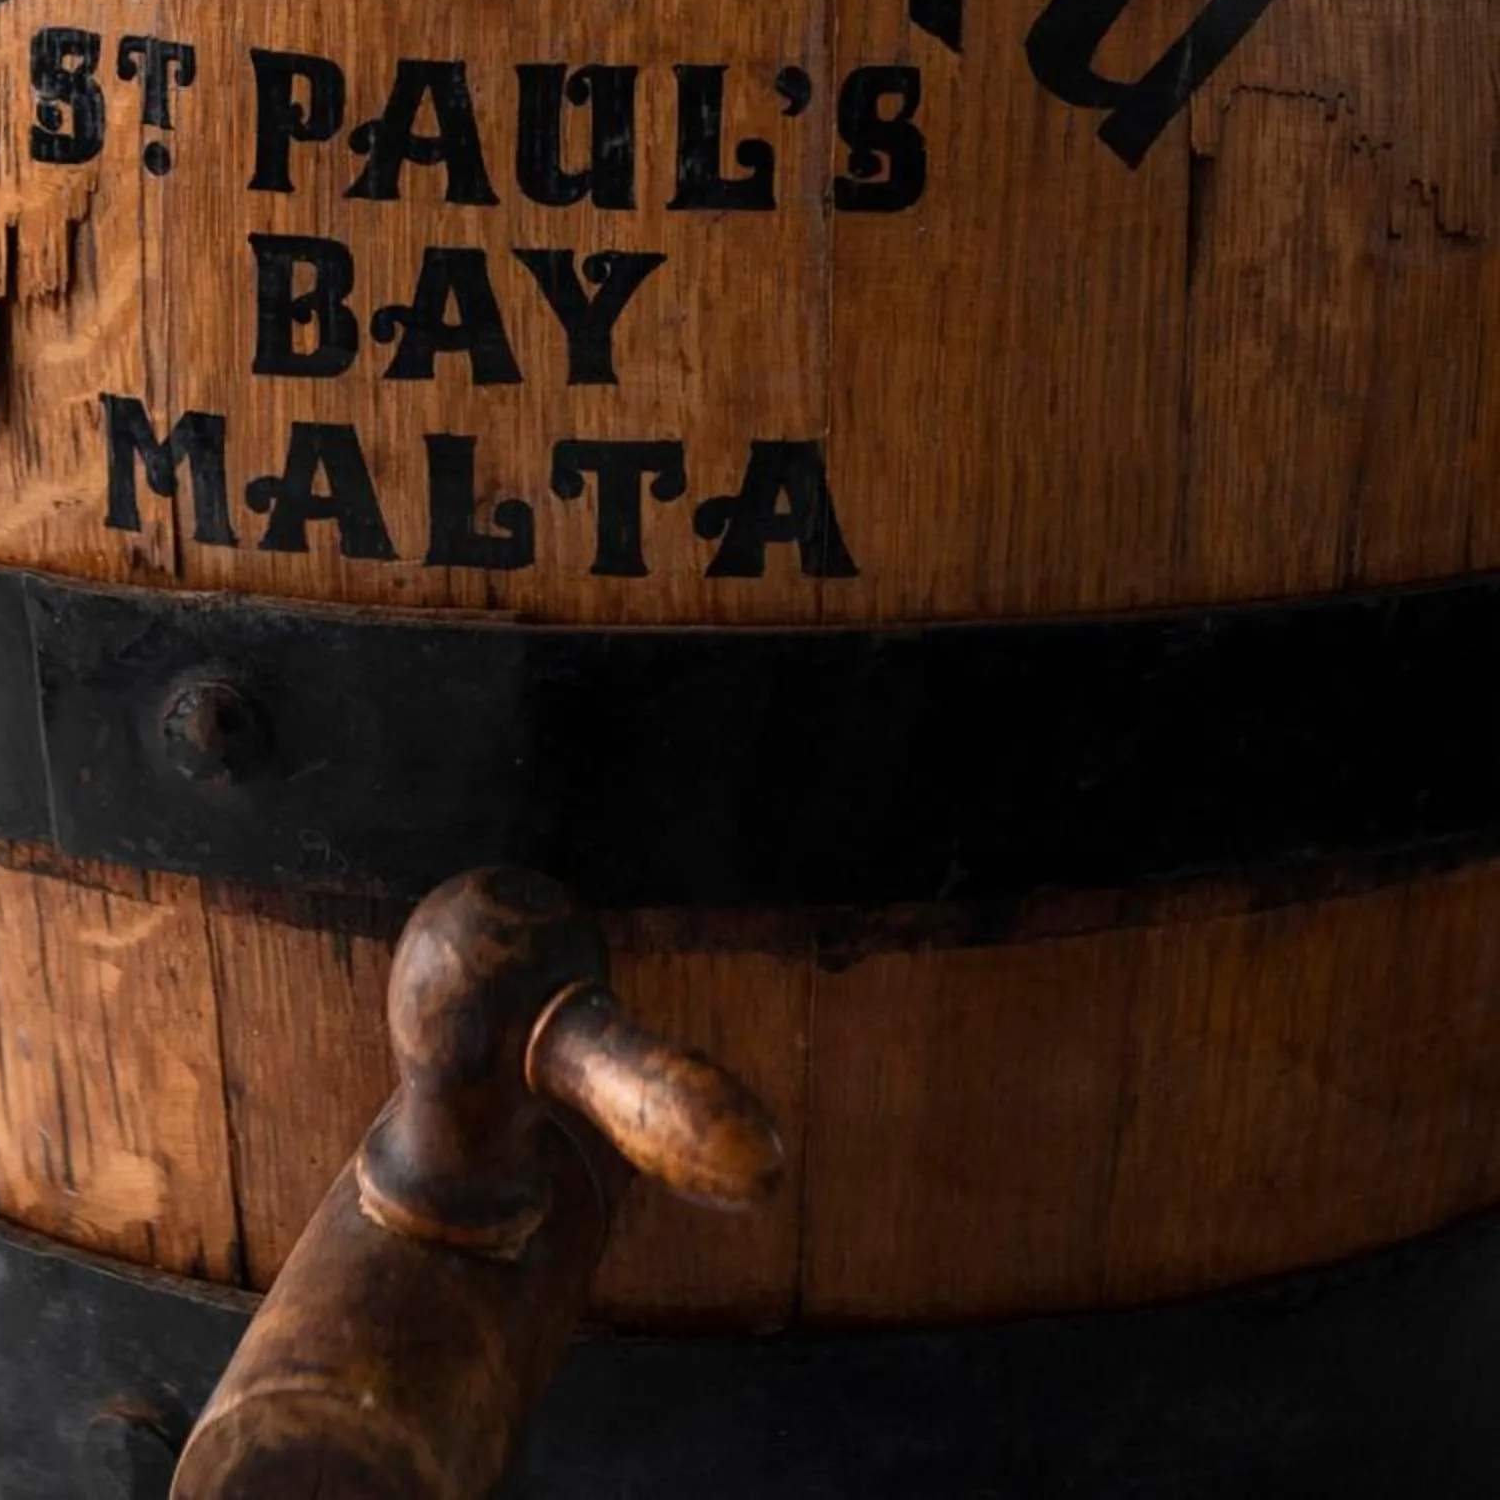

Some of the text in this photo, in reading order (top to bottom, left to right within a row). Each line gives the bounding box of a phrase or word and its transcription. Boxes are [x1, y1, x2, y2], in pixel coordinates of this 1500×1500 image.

[249, 49, 925, 212] PAUL'S
[249, 233, 666, 387] BAY
[102, 394, 859, 578] MALTA
